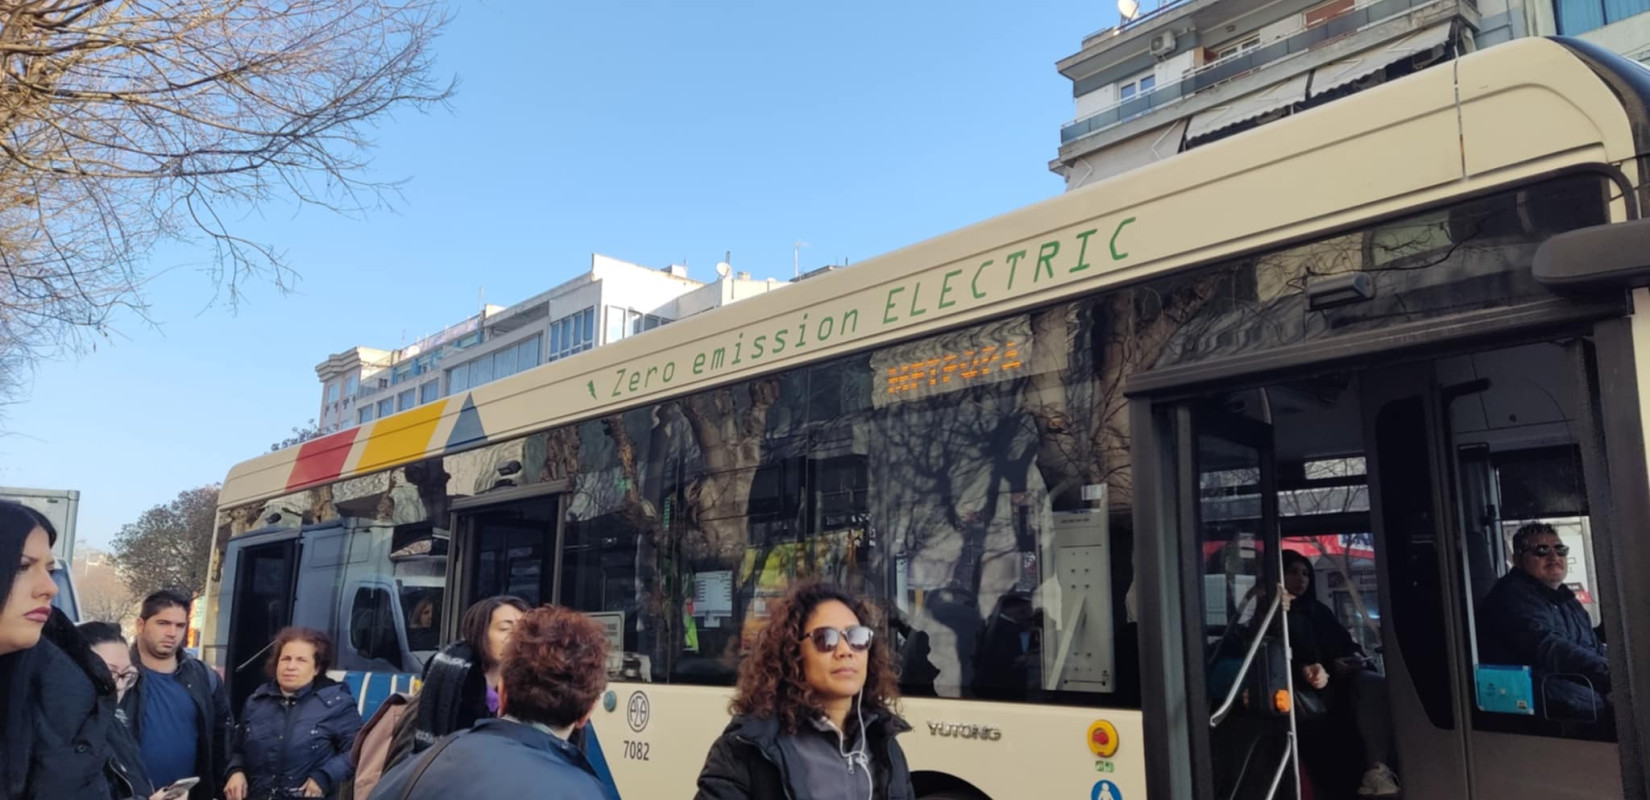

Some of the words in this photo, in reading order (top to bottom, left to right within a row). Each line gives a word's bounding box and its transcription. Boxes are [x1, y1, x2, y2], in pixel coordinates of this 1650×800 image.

[611, 361, 675, 397] Zero
[692, 309, 858, 374] emission
[882, 217, 1137, 325] ELECTRIC
[926, 720, 1002, 741] YUTONG
[623, 740, 650, 761] 7082
